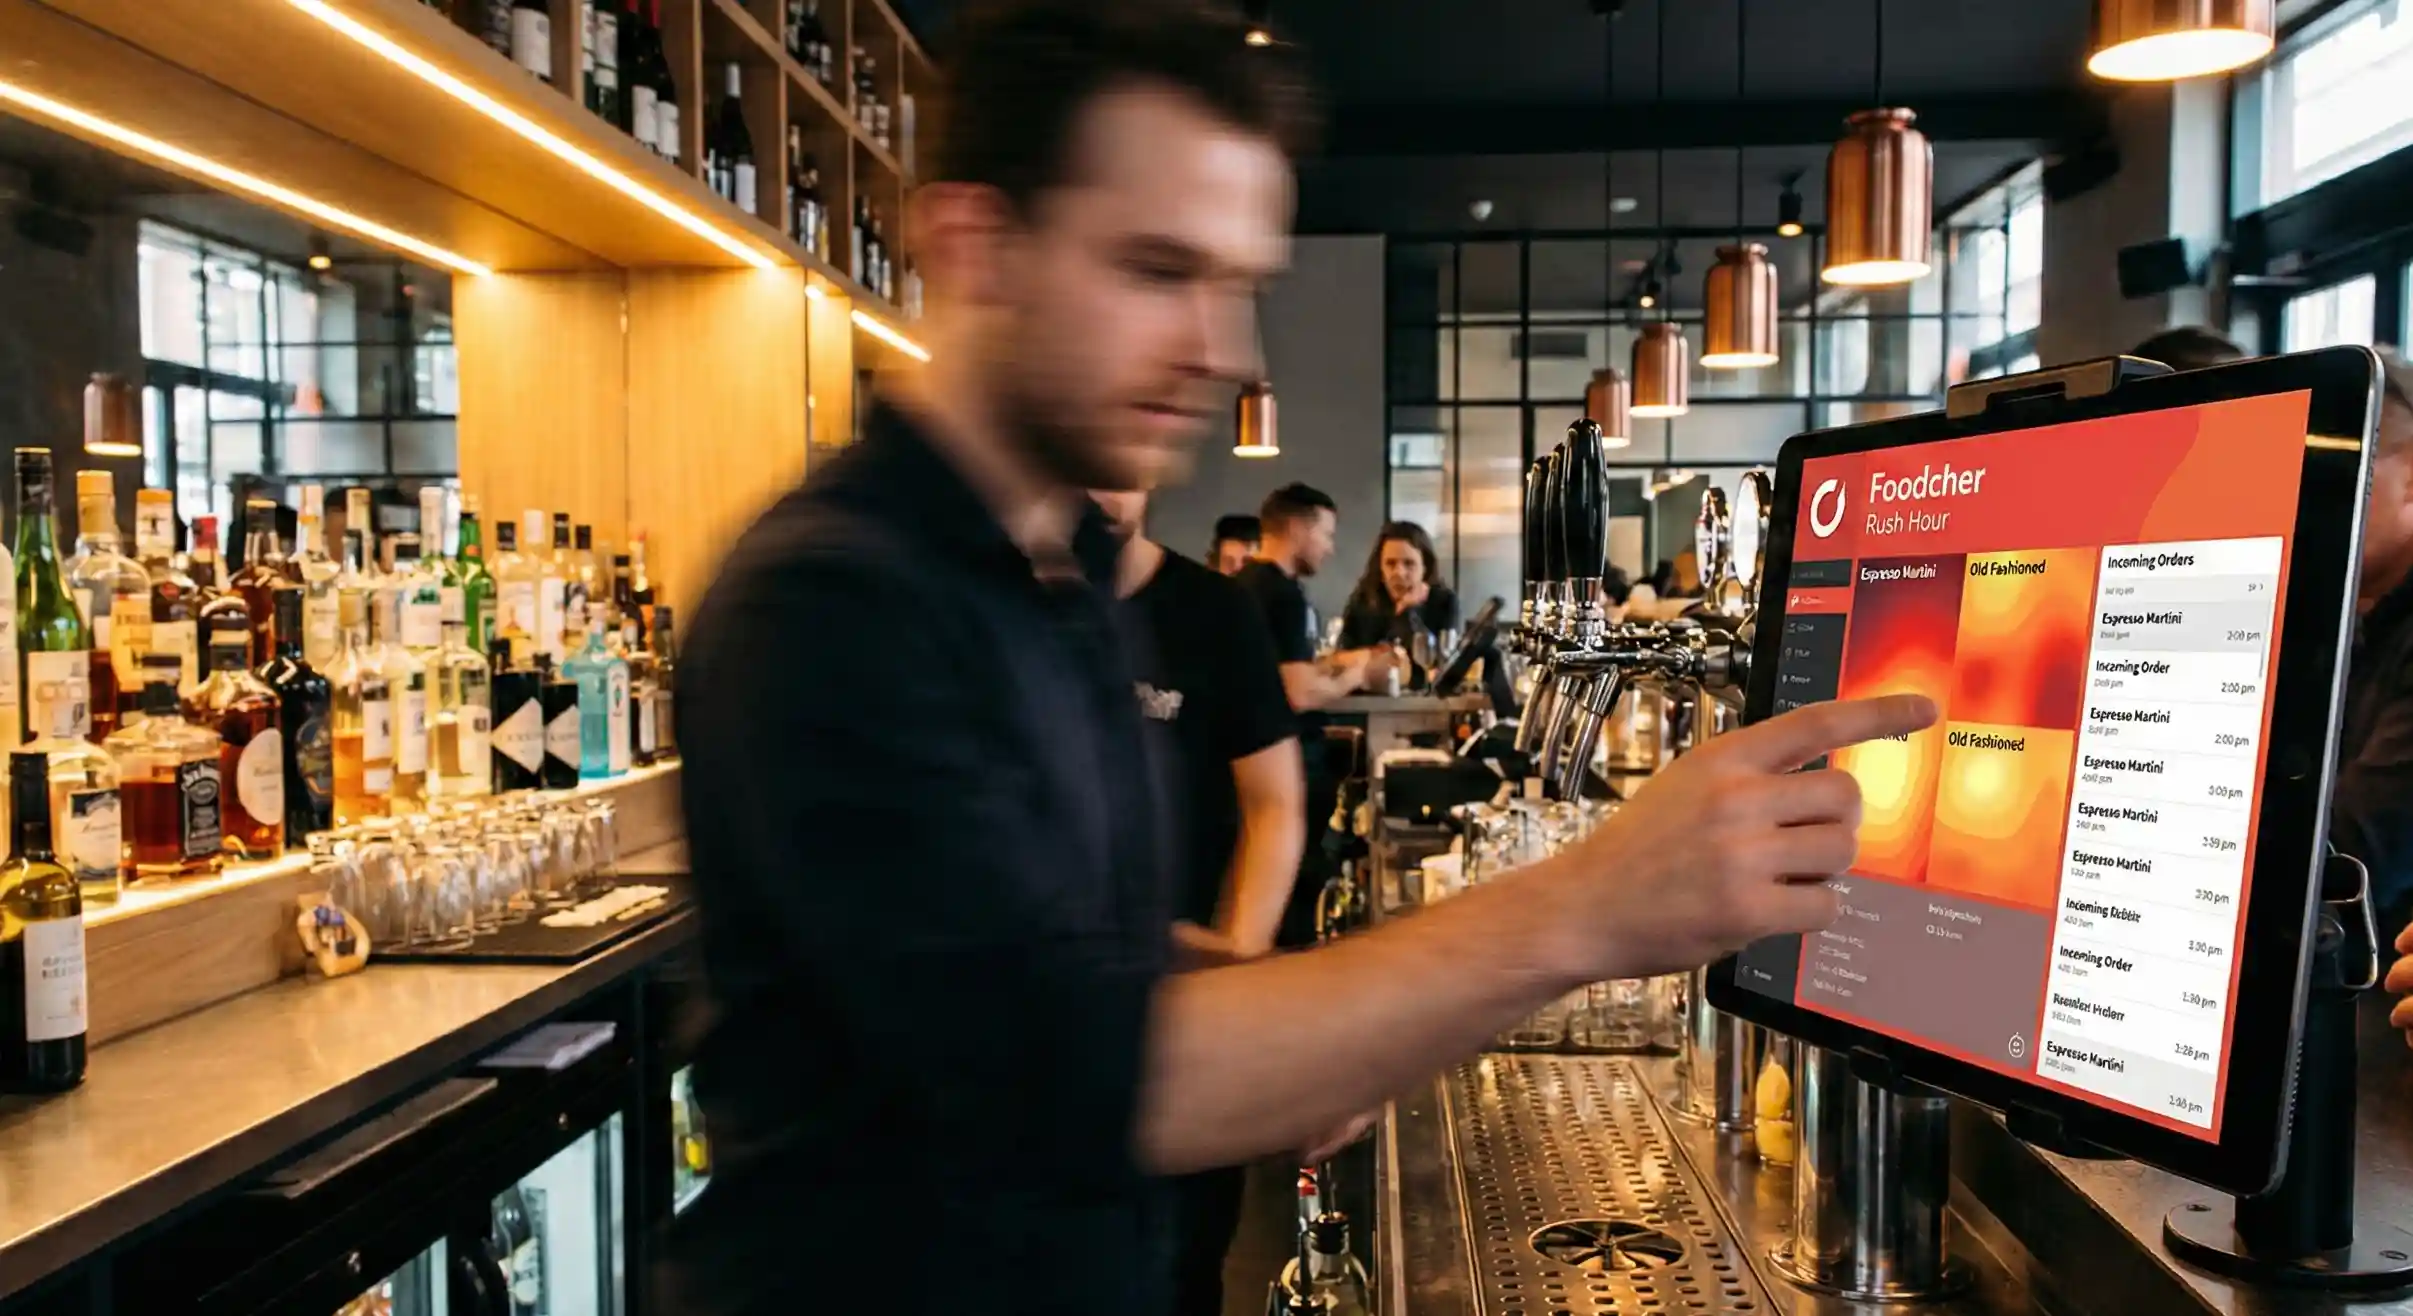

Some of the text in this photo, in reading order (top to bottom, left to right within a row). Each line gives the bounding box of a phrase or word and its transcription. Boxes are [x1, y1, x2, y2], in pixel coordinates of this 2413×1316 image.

[1870, 463, 1986, 503] Foodcher
[1866, 509, 1950, 535] Rush Hour
[1970, 561, 1987, 576] Old
[2141, 661, 2170, 674] Order
[2134, 709, 2170, 723] Martini
[1949, 732, 1967, 747] Old
[2128, 758, 2164, 774] Martini
[2116, 854, 2152, 873] Martini
